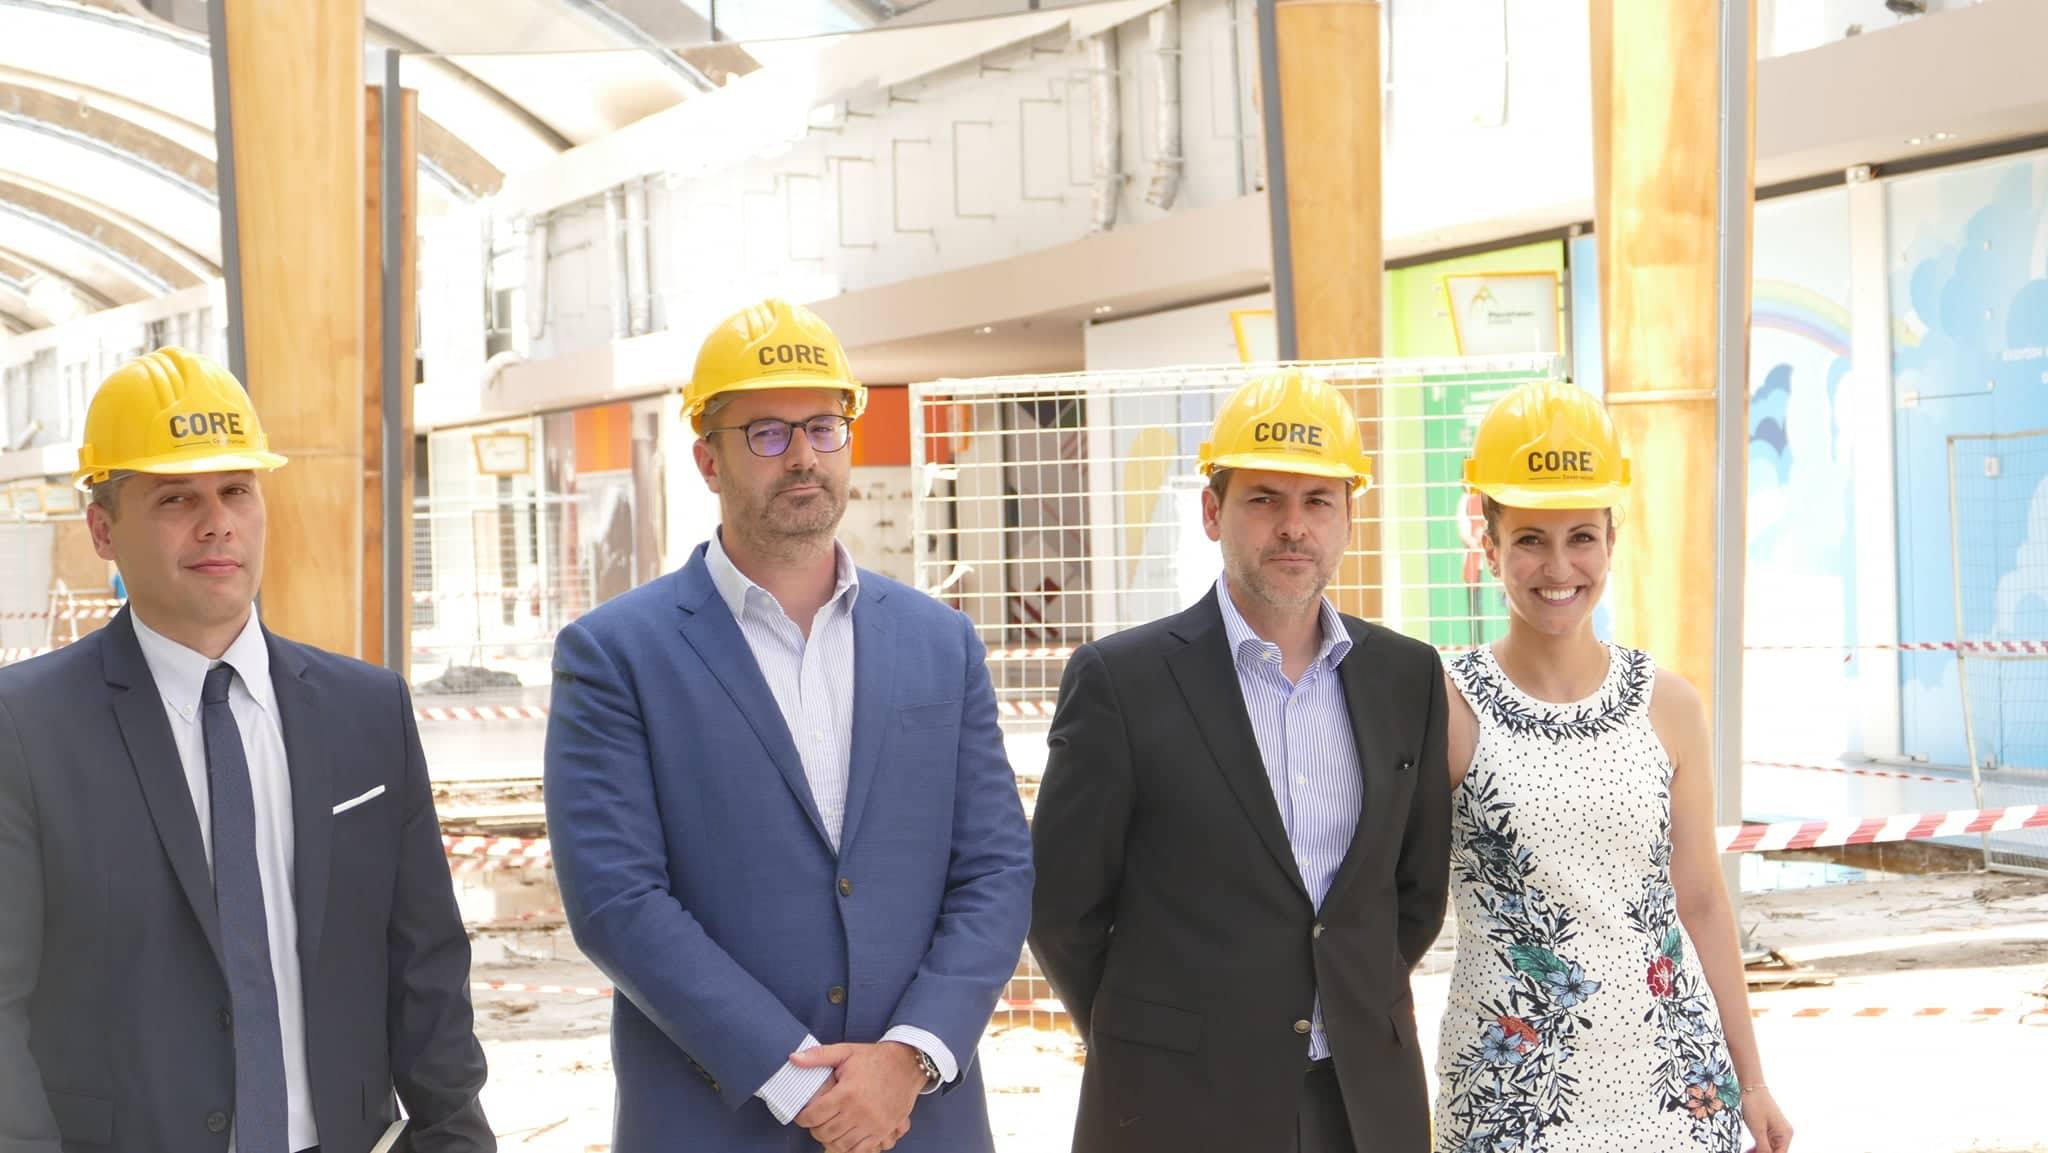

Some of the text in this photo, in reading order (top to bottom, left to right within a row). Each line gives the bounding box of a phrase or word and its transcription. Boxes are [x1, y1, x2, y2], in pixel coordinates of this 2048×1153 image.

[758, 344, 829, 367] CORE
[169, 412, 244, 438] CORE
[1254, 422, 1323, 447] CORE
[1528, 451, 1594, 472] CORE
